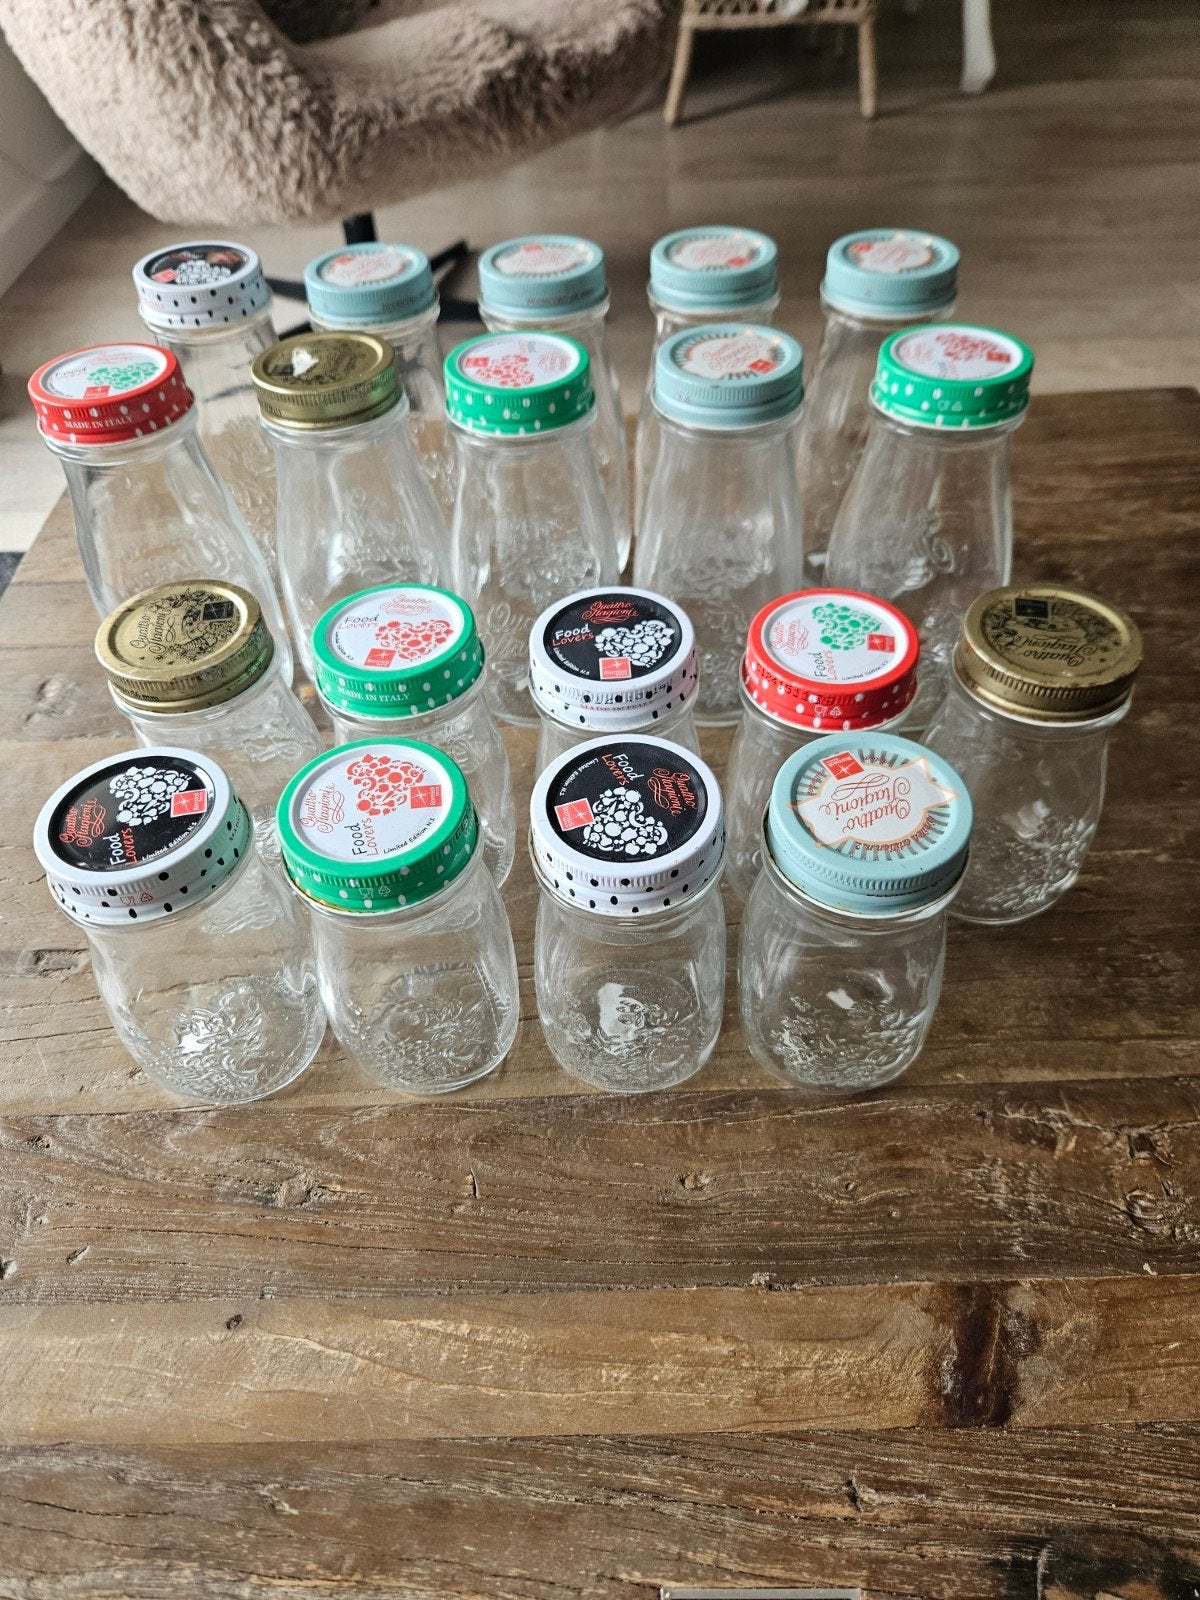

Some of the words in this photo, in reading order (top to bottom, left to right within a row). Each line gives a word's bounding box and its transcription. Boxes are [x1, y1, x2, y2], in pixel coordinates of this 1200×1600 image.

[64, 419, 92, 429] MADE
[92, 420, 103, 428] IN
[104, 416, 134, 427] ITALY
[345, 613, 380, 624] Food
[590, 601, 634, 610] Quattro
[338, 622, 379, 630] Lovers
[552, 633, 595, 647] Lovers
[555, 623, 591, 640] Food
[807, 651, 828, 678] Food
[823, 650, 838, 680] Lovers
[1023, 650, 1086, 667] Quattro
[337, 686, 364, 700] MADE
[366, 693, 377, 702] IN
[379, 693, 410, 702] ITALY
[601, 753, 630, 786] Lovers
[613, 753, 644, 781] Food
[652, 767, 685, 817] Stagioni
[672, 771, 698, 810] Quattro
[819, 776, 911, 821] Stagioni
[76, 797, 100, 847] Stagioni
[299, 789, 318, 828] Quattro
[317, 782, 339, 834] Stagioni
[842, 795, 911, 834] Quattro
[59, 805, 79, 843] Quattro
[344, 822, 367, 855] Food
[363, 817, 379, 856] Lovers
[103, 833, 126, 866] Food
[121, 827, 138, 866] Lovers
[141, 845, 169, 861] Limited
[168, 831, 189, 848] Edition
[383, 841, 408, 855] Limited
[408, 827, 428, 843] Edition
